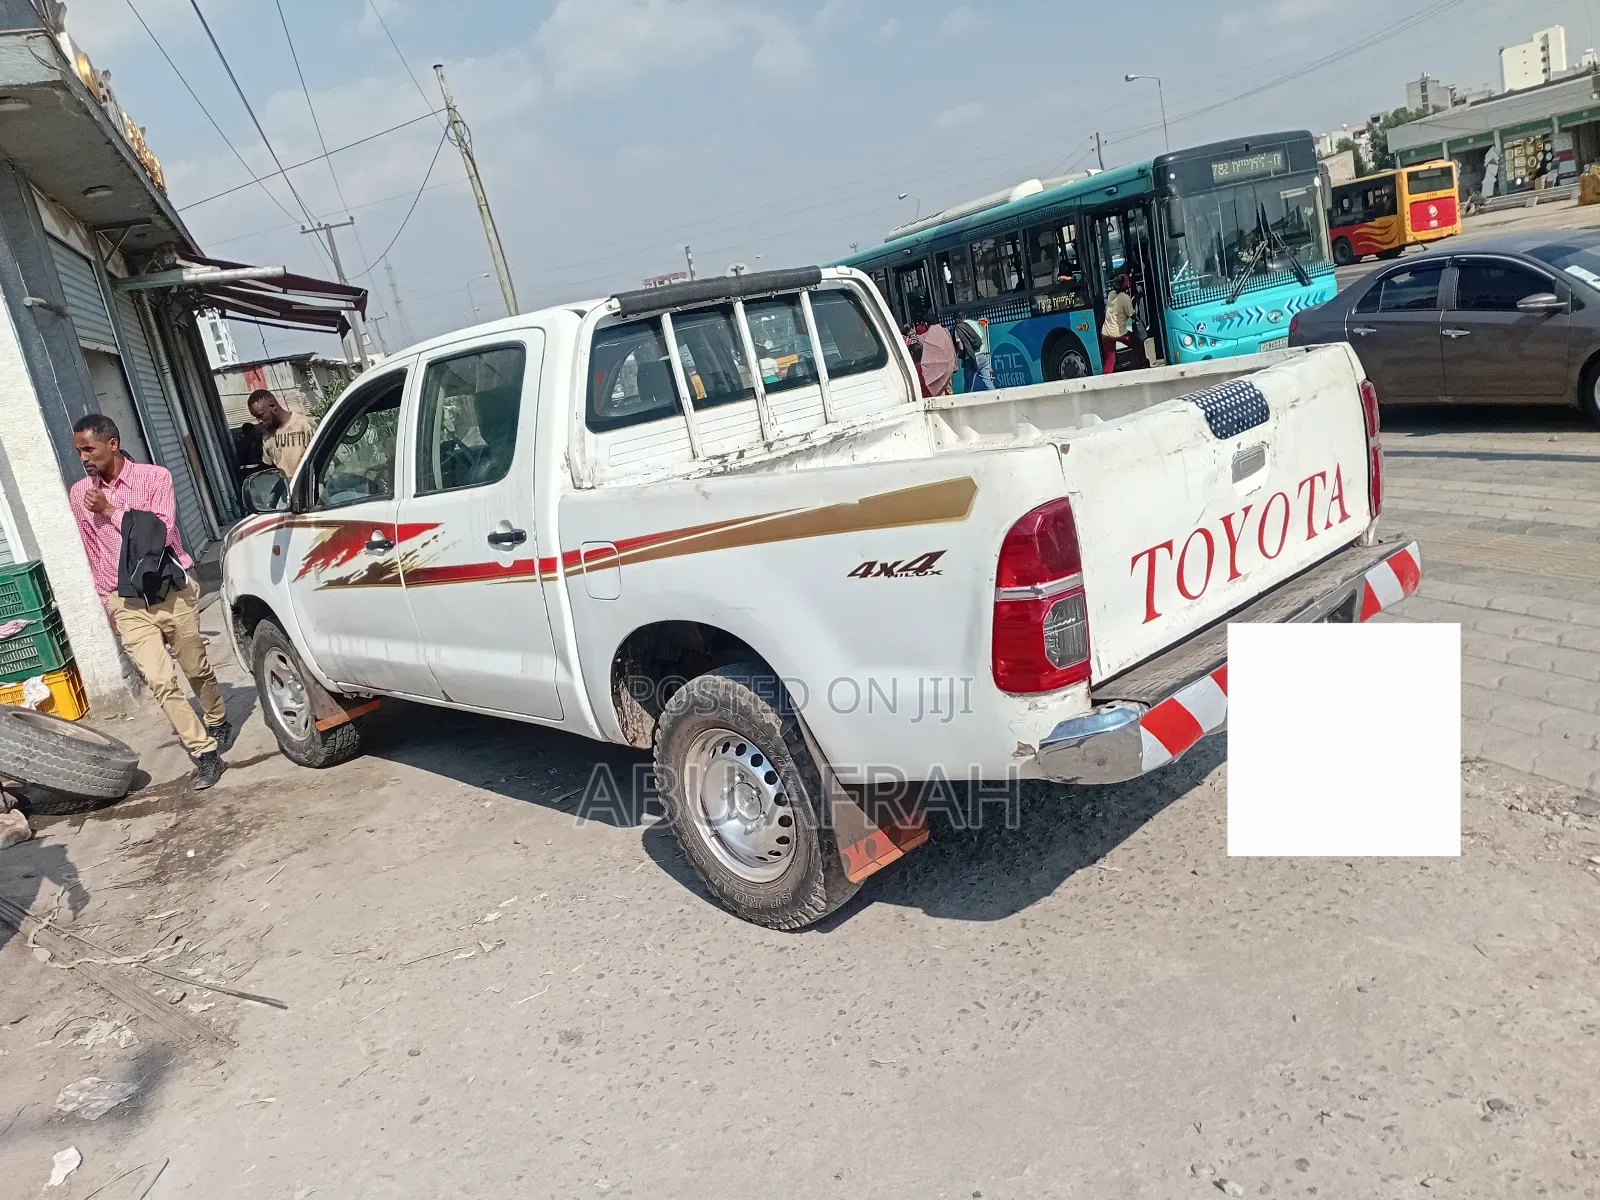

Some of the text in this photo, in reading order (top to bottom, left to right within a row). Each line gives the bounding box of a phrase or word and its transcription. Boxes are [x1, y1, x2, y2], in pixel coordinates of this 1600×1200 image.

[993, 352, 1023, 370] ሸገር
[997, 371, 1026, 387] SHEGER
[1130, 462, 1352, 625] TOYOTA
[887, 570, 943, 578] HILUX
[708, 872, 762, 909] ROAD
